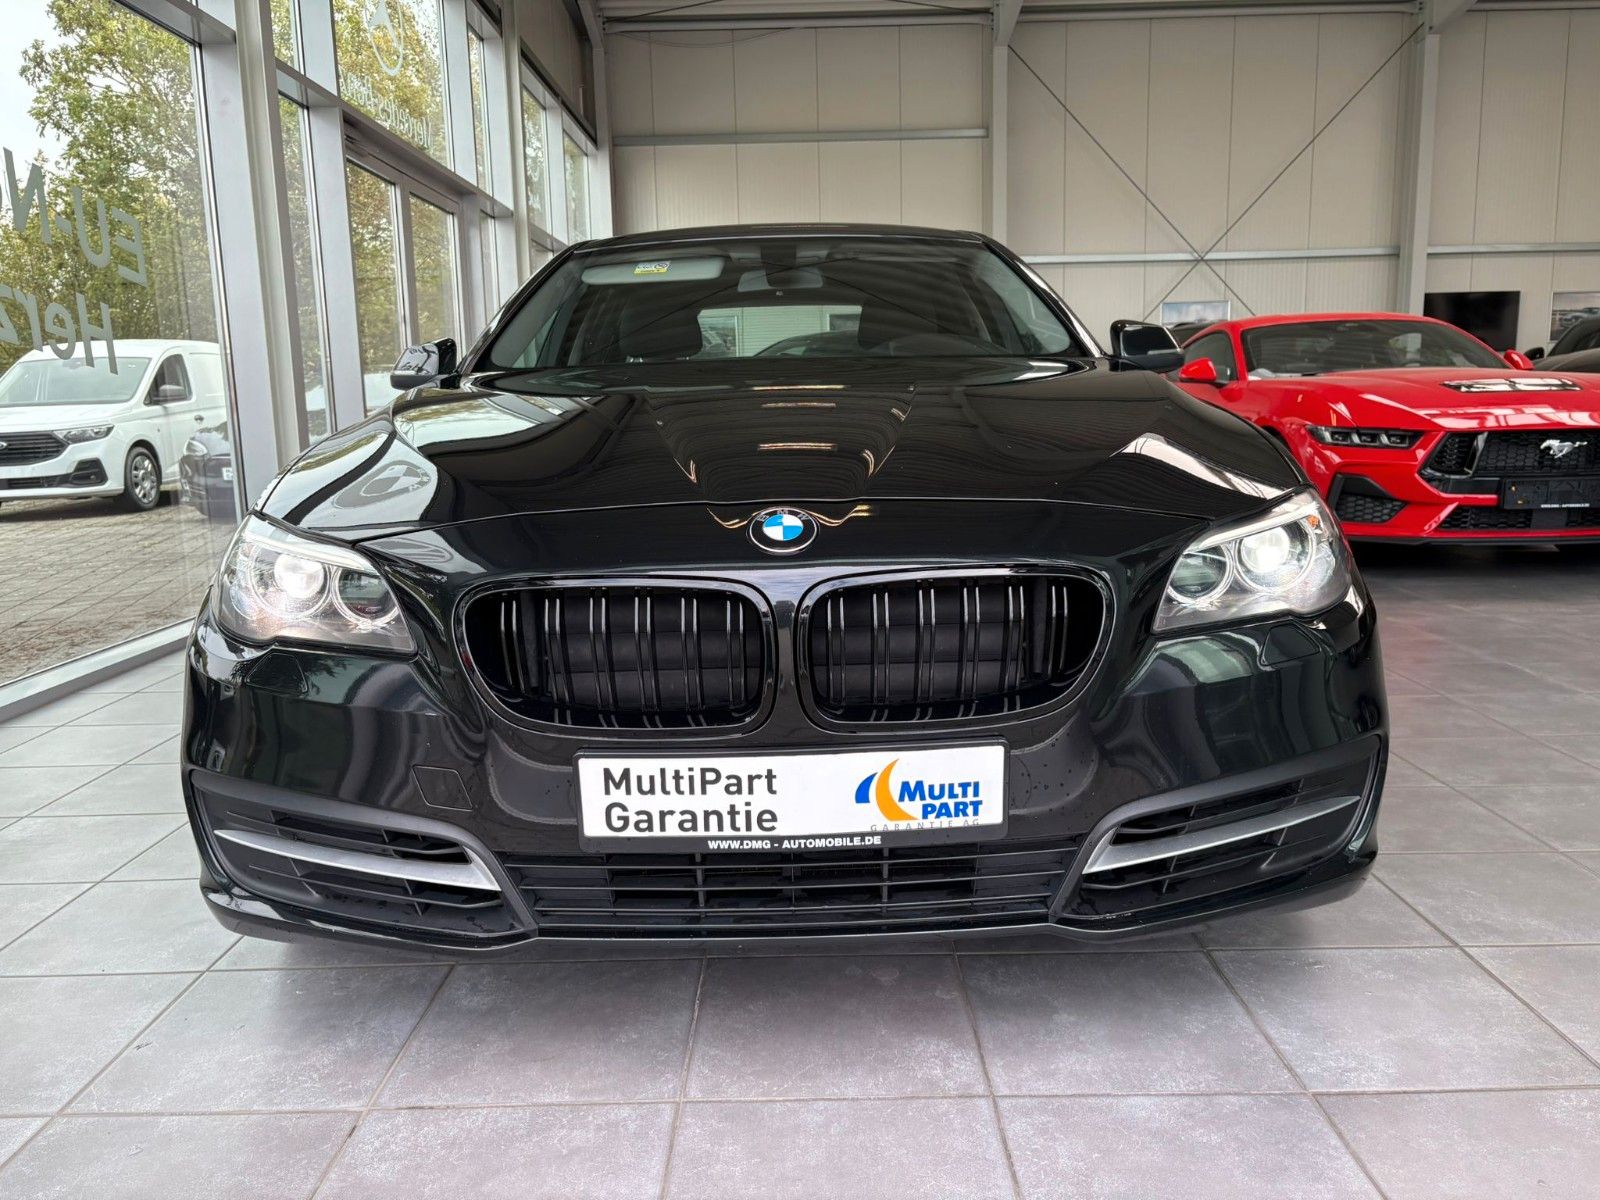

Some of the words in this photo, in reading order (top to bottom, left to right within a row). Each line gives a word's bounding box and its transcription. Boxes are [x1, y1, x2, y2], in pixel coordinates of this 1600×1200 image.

[602, 767, 778, 796] MultiPart
[898, 780, 980, 803] MULTI
[604, 801, 779, 833] Garantie
[921, 800, 983, 820] PART
[870, 820, 954, 832] GARANTIE
[962, 818, 980, 827] AG
[707, 838, 772, 850] WWW.DMG
[782, 835, 882, 849] AUTOMOBILE.DE
